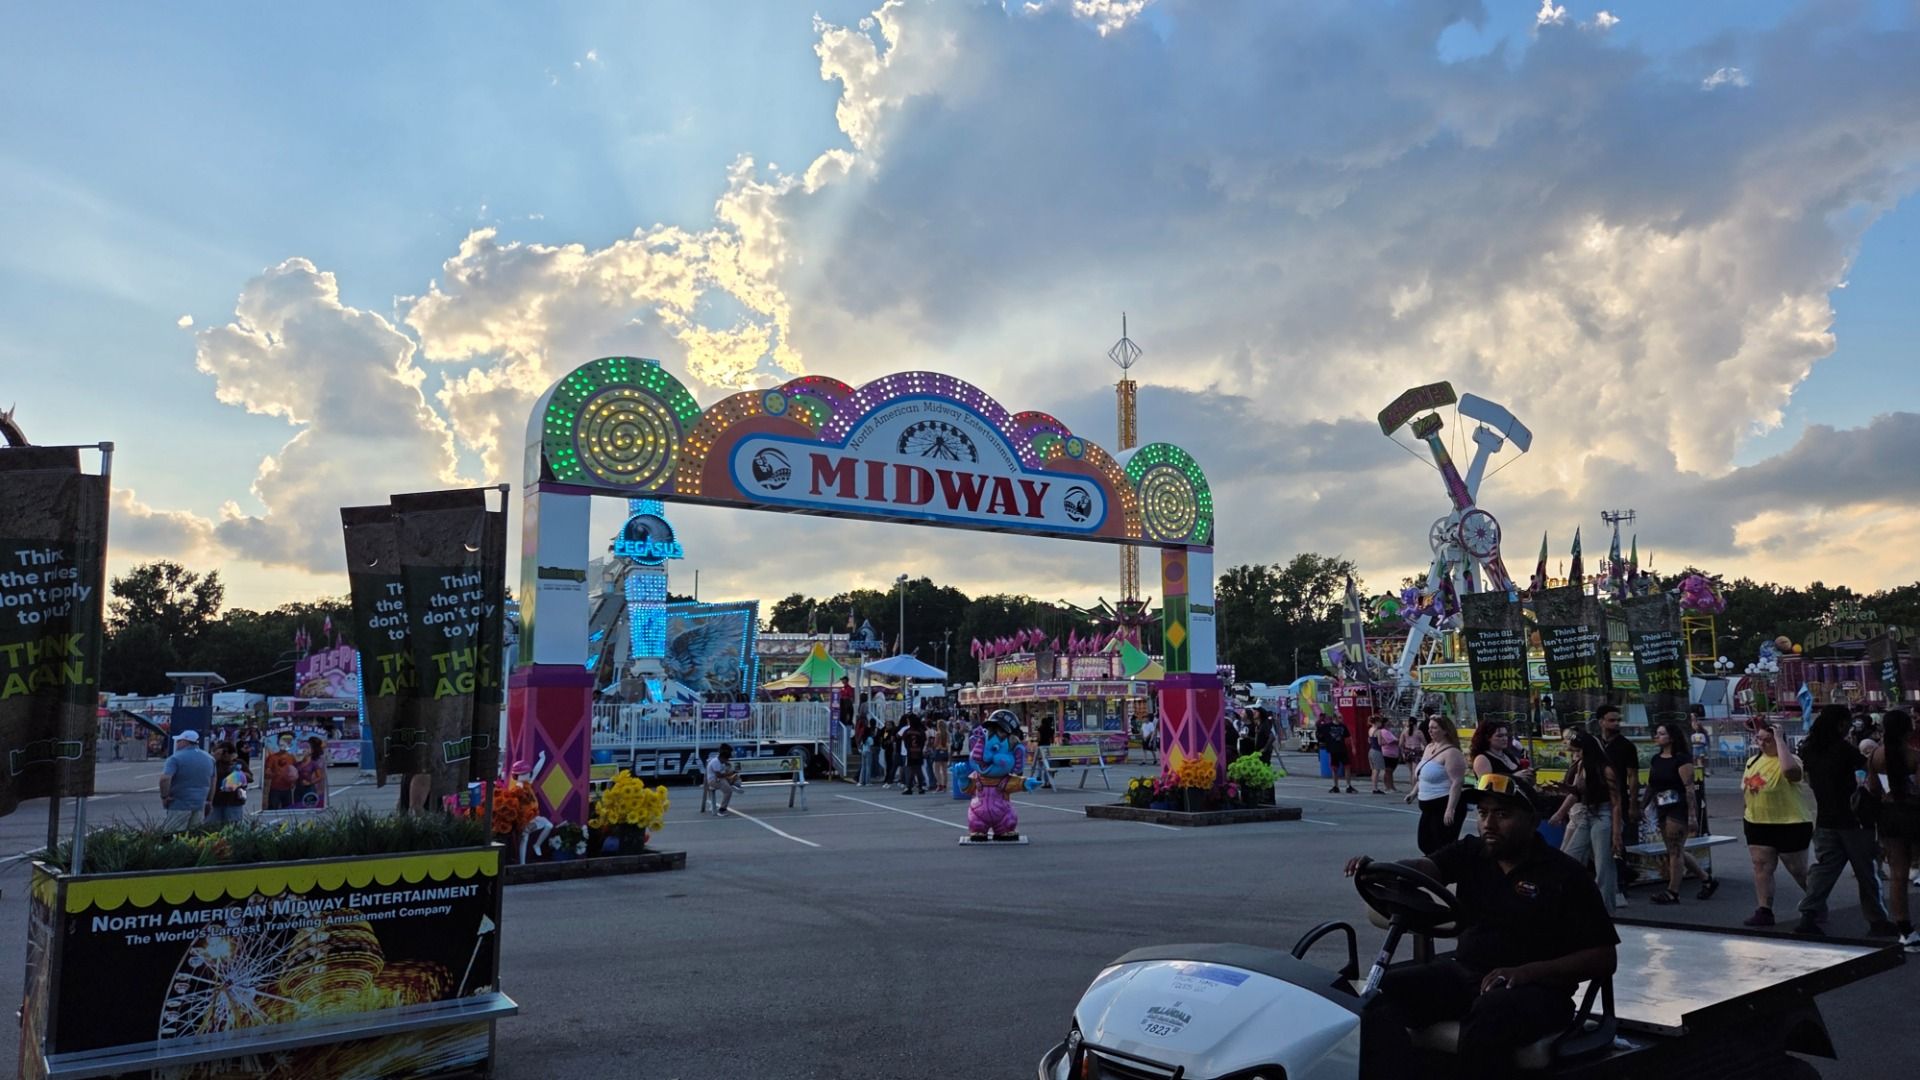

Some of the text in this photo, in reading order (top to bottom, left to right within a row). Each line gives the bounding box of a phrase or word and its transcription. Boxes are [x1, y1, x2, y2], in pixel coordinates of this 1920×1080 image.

[849, 401, 1018, 475] North American Midway Entertainment
[810, 459, 1051, 519] MIDWAY
[614, 535, 685, 557] PEGASUS
[0, 566, 78, 588] the rles
[49, 582, 92, 602] pply
[376, 600, 403, 612] the
[430, 593, 459, 608] the
[17, 610, 41, 625] to
[368, 612, 409, 628] don't
[423, 607, 468, 625] don't
[388, 629, 405, 641] to
[442, 626, 463, 638] to
[1342, 593, 1362, 663] ATM
[1478, 631, 1500, 640] Think
[1553, 628, 1576, 637] Think
[1487, 639, 1525, 647] necessary
[0, 633, 86, 669] THNK
[1553, 653, 1575, 661] hand
[1479, 667, 1522, 681] THINK
[1480, 679, 1527, 693] AGAIN.
[92, 885, 479, 932] NORTH AMERICAN MIDWAY ENTERTAINMENT
[125, 904, 453, 945] The World's Largest Traveling Amusement Company
[1144, 1023, 1170, 1036] 1823
